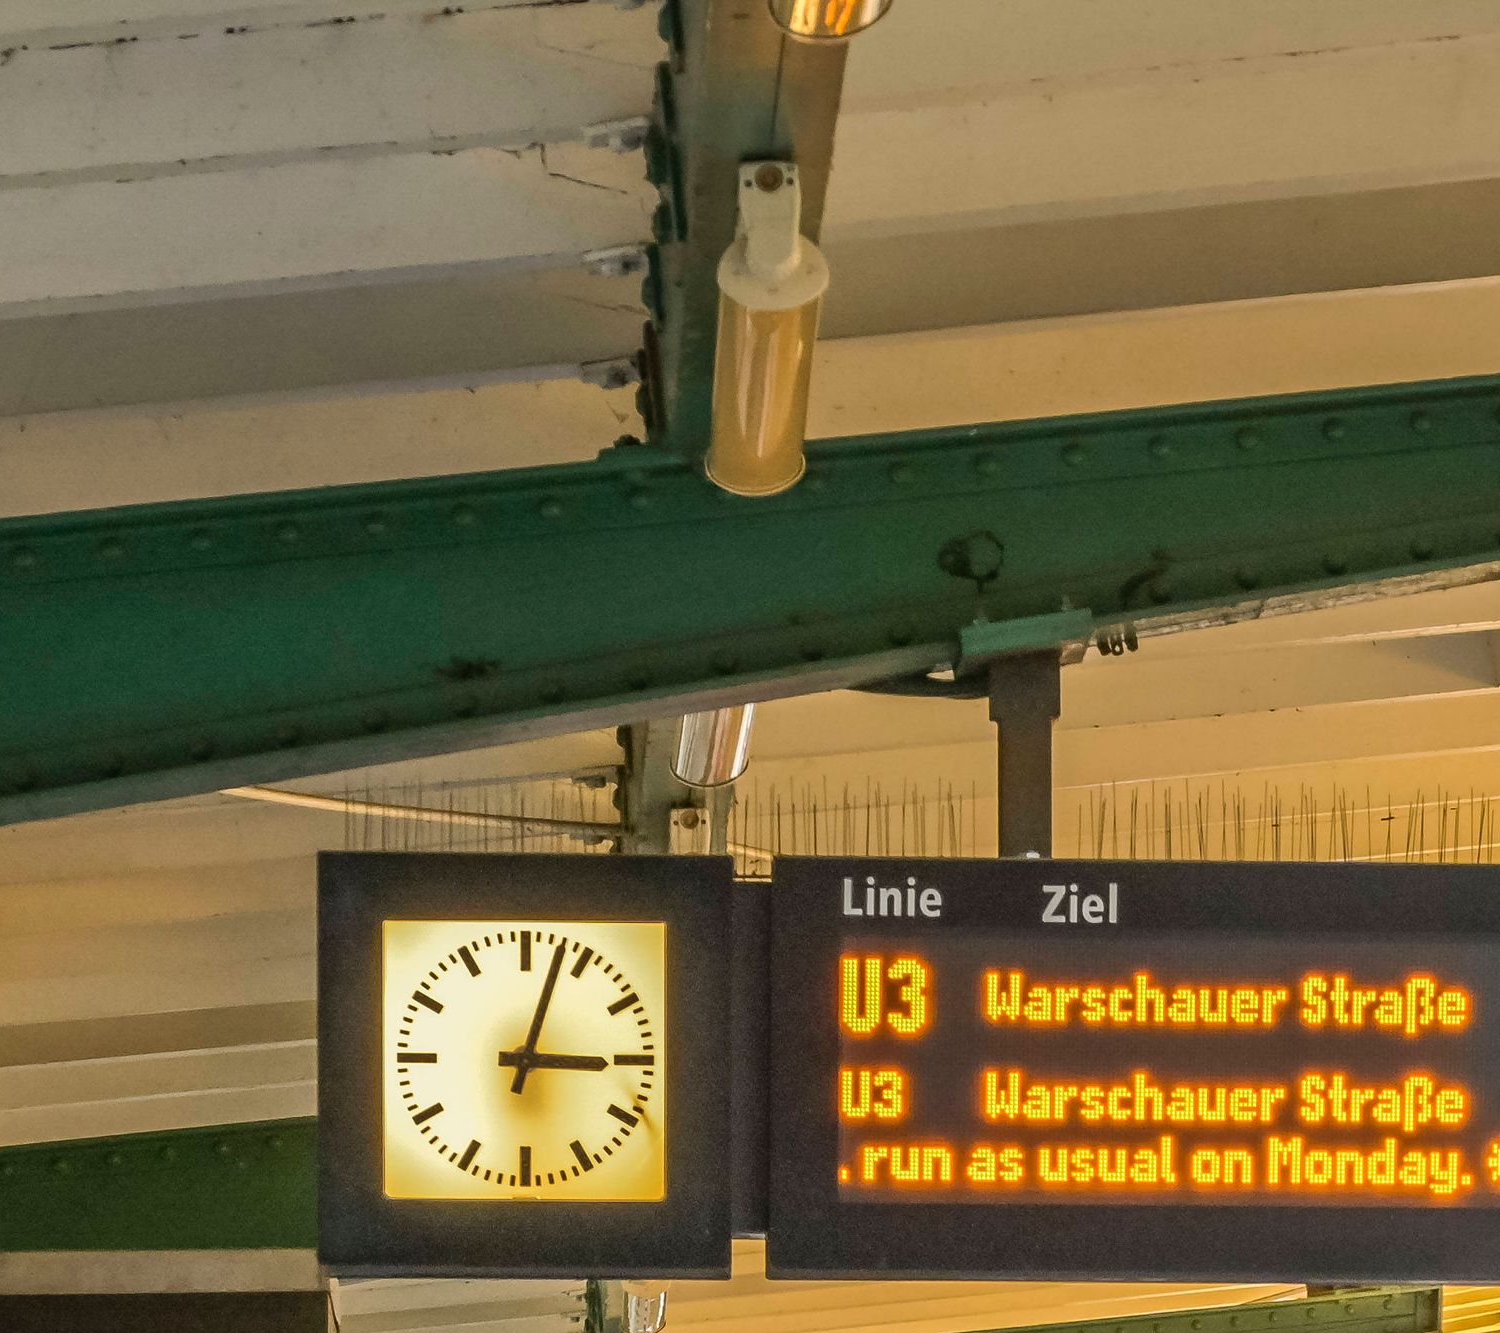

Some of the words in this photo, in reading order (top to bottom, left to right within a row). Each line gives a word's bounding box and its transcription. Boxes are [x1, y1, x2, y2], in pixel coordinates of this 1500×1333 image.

[843, 877, 942, 917] Linie
[1042, 883, 1118, 923] Ziel
[841, 959, 927, 1033] U3
[986, 971, 1288, 1024] Warschauer
[1302, 976, 1469, 1034] Straße
[840, 1070, 902, 1118] U3
[985, 1071, 1285, 1122] Warschauer
[1300, 1075, 1465, 1132] Straße
[863, 1145, 953, 1182] run
[968, 1146, 1024, 1183] as
[1039, 1136, 1177, 1184] usual
[1192, 1148, 1252, 1184] on
[1268, 1137, 1473, 1194] Monday.
